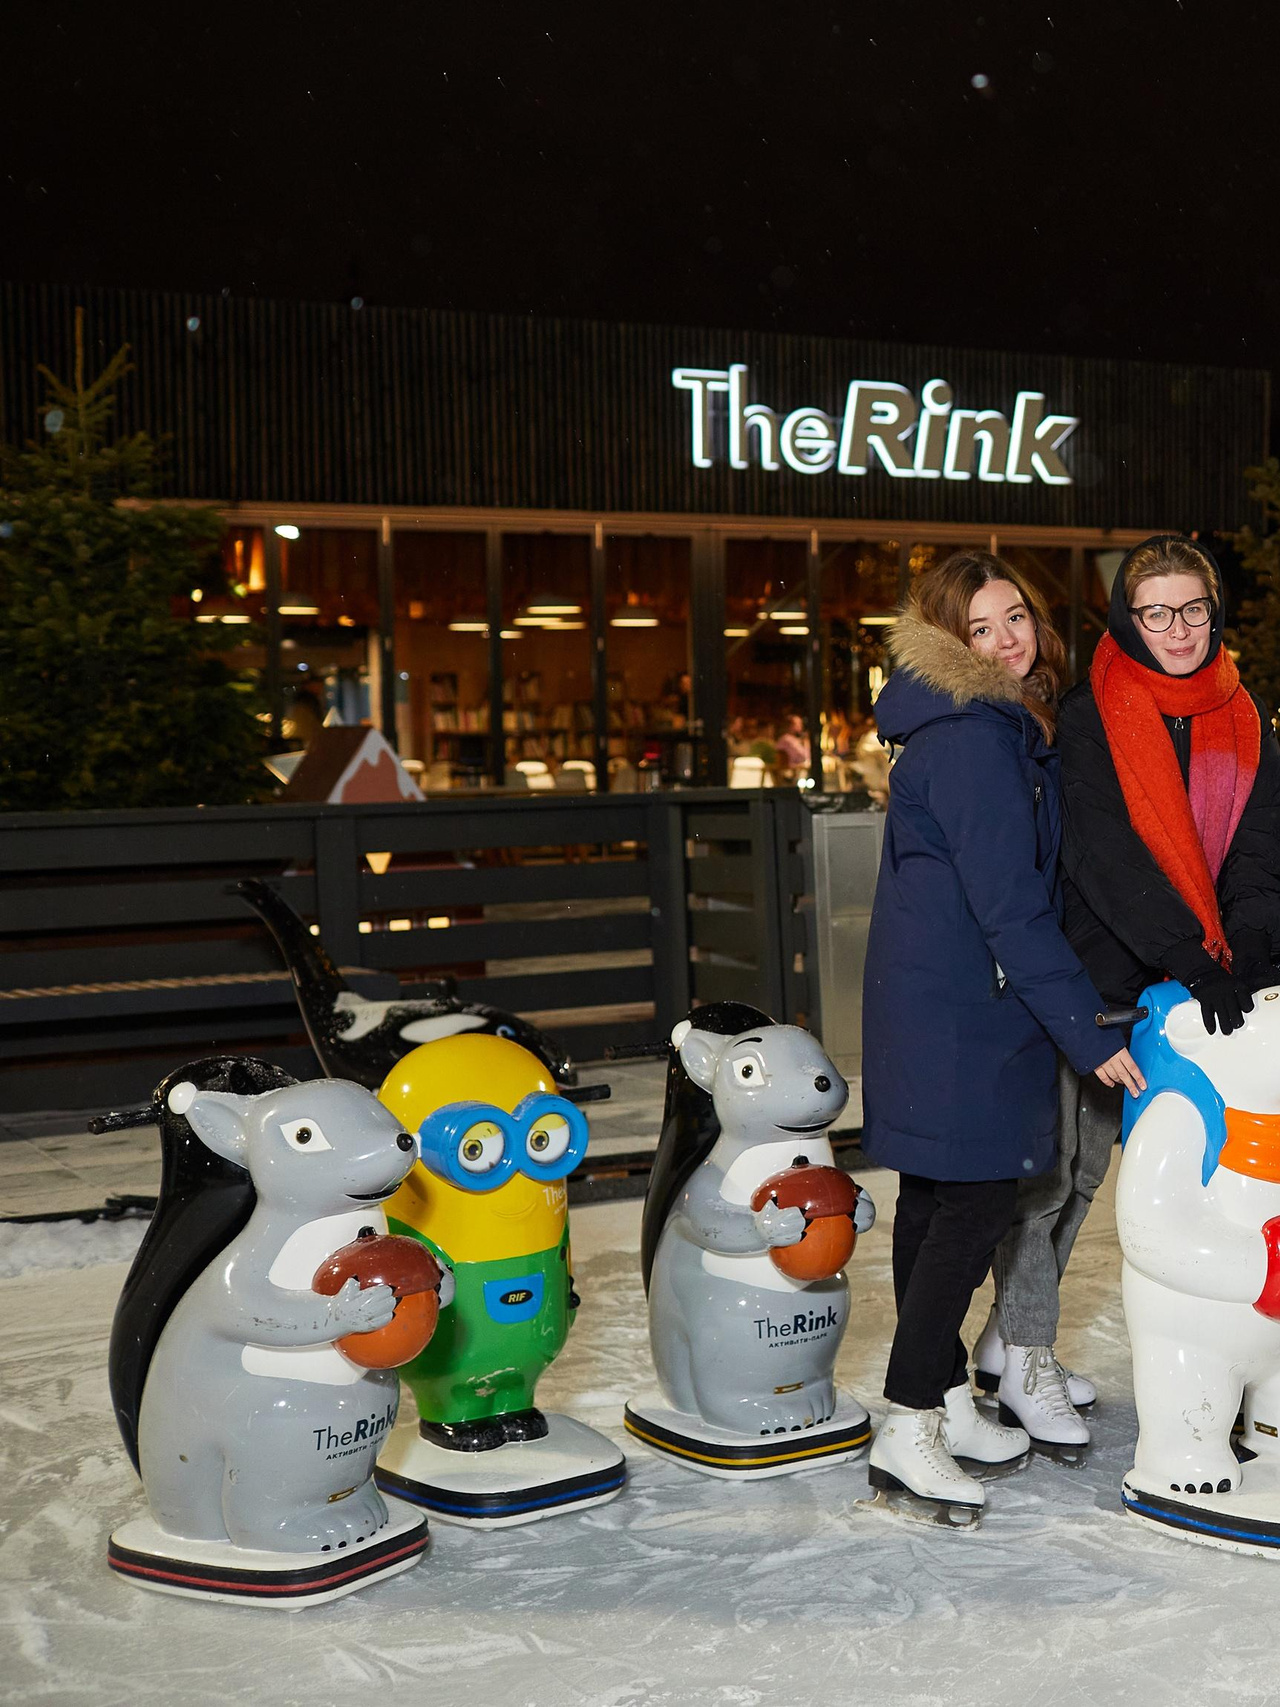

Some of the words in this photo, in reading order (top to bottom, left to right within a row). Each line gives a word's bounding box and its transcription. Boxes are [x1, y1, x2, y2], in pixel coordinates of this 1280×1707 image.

[672, 363, 1079, 485] TheRink
[508, 1292, 526, 1303] RIF
[753, 1305, 838, 1340] TheRink
[312, 1404, 395, 1451] TheRink
